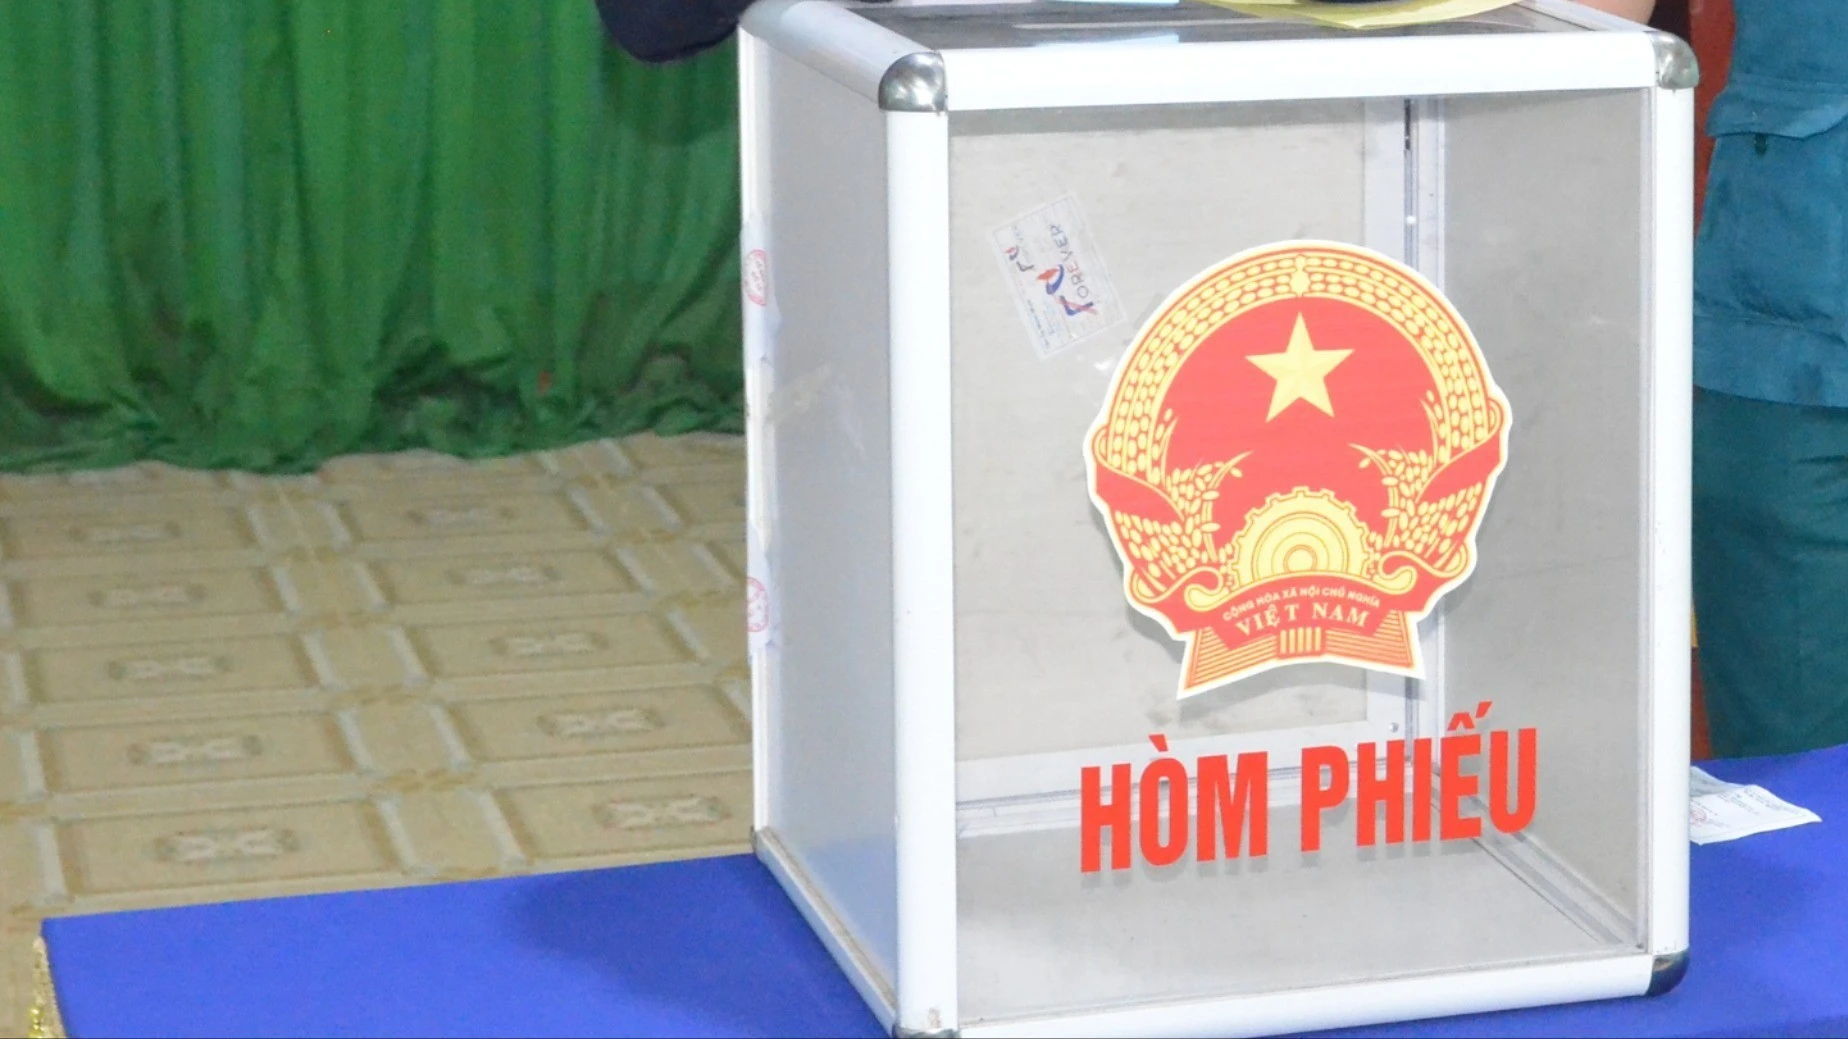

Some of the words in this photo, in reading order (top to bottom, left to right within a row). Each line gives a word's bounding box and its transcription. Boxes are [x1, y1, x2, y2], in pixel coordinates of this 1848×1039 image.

[1223, 600, 1255, 621] CỘNG
[1256, 592, 1281, 605] HÒA
[1282, 587, 1297, 600] XÃ
[1299, 585, 1320, 599] HỘI
[1321, 586, 1346, 599] CHỦ
[1347, 591, 1381, 608] NGHĨA
[1235, 604, 1299, 636] VIỆT
[1312, 602, 1370, 627] NAM
[1080, 733, 1269, 874] HÒM
[1300, 701, 1538, 852] PHIẾU
